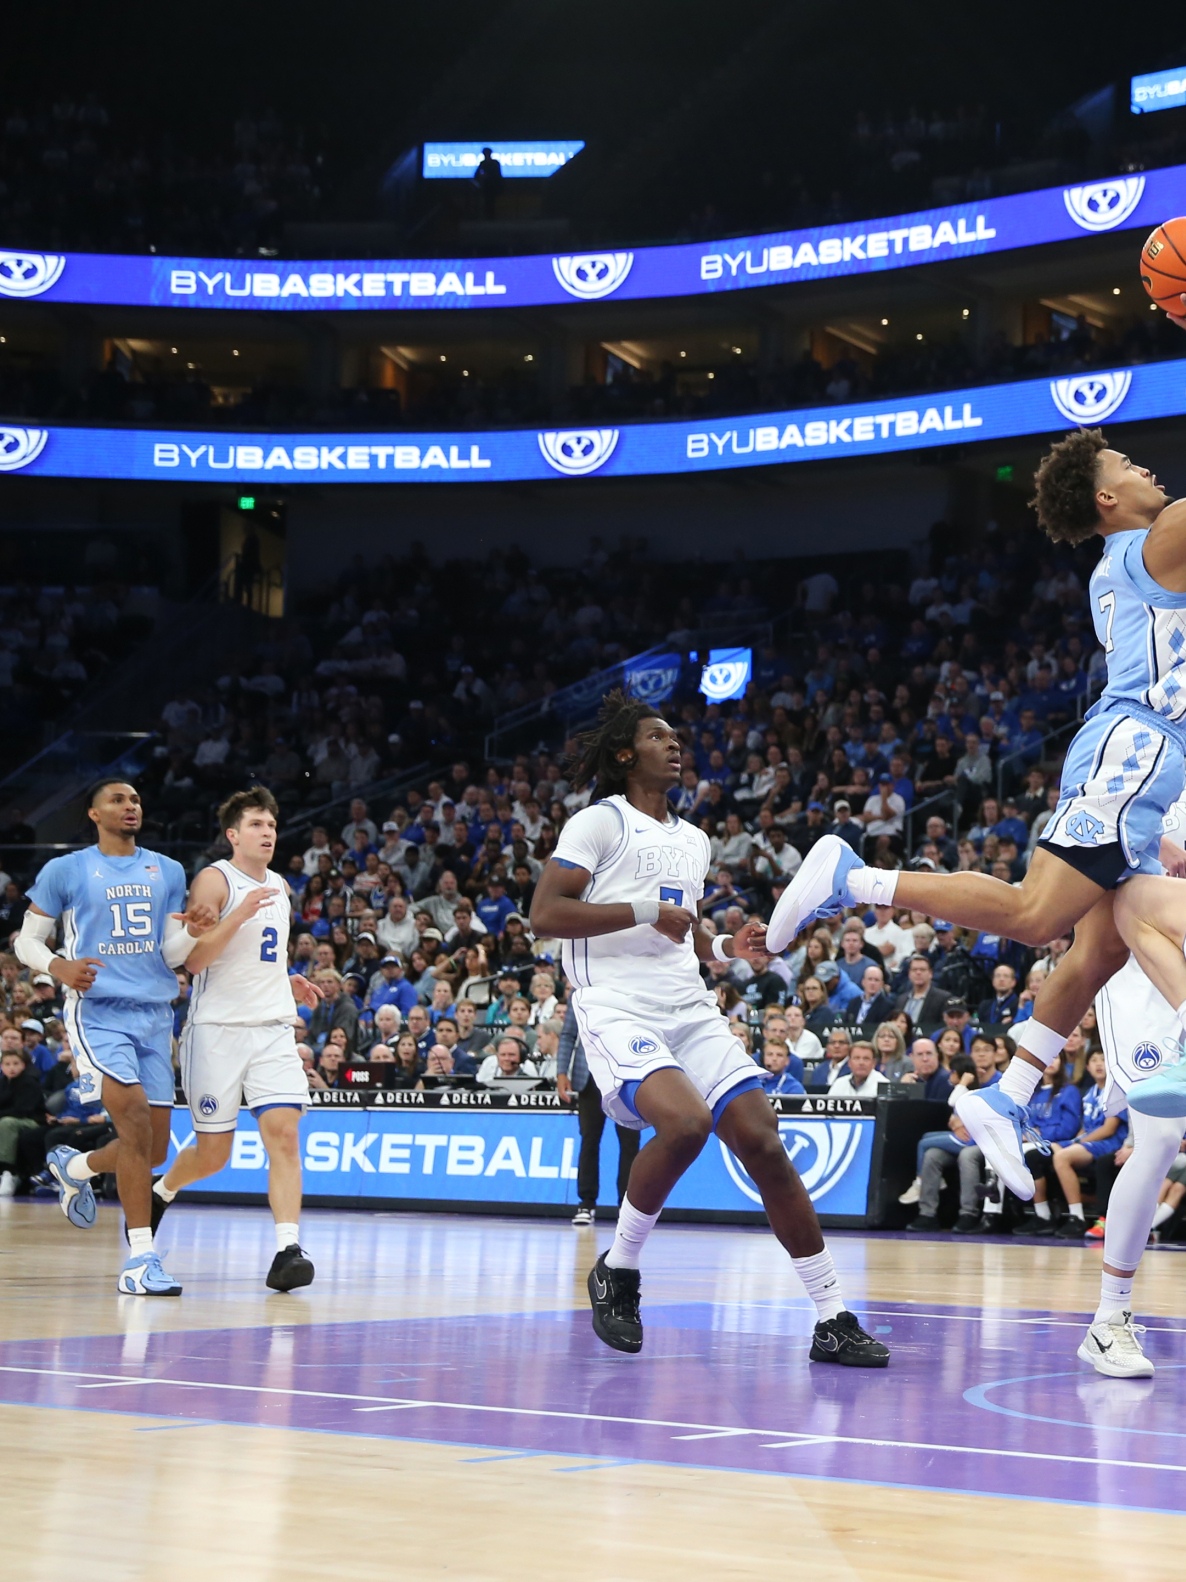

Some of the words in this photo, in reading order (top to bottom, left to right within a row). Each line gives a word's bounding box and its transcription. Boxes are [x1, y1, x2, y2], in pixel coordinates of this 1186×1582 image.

[700, 215, 996, 280] BYUBASKETBALL
[170, 270, 506, 297] BYUBASKETBALL
[687, 403, 983, 459] BYUBASKETBALL
[153, 443, 491, 470] BYUBASKETBALL
[1098, 590, 1115, 654] 7
[635, 846, 702, 889] BYU
[106, 884, 152, 900] NORTH
[110, 902, 152, 938] 15
[260, 927, 278, 962] 2
[352, 1071, 370, 1083] POSS
[323, 1091, 361, 1104] DELTA
[386, 1092, 425, 1104] DELTA
[451, 1093, 492, 1106] DELTA
[520, 1094, 561, 1107] DELTA
[815, 1099, 863, 1112] DELTA
